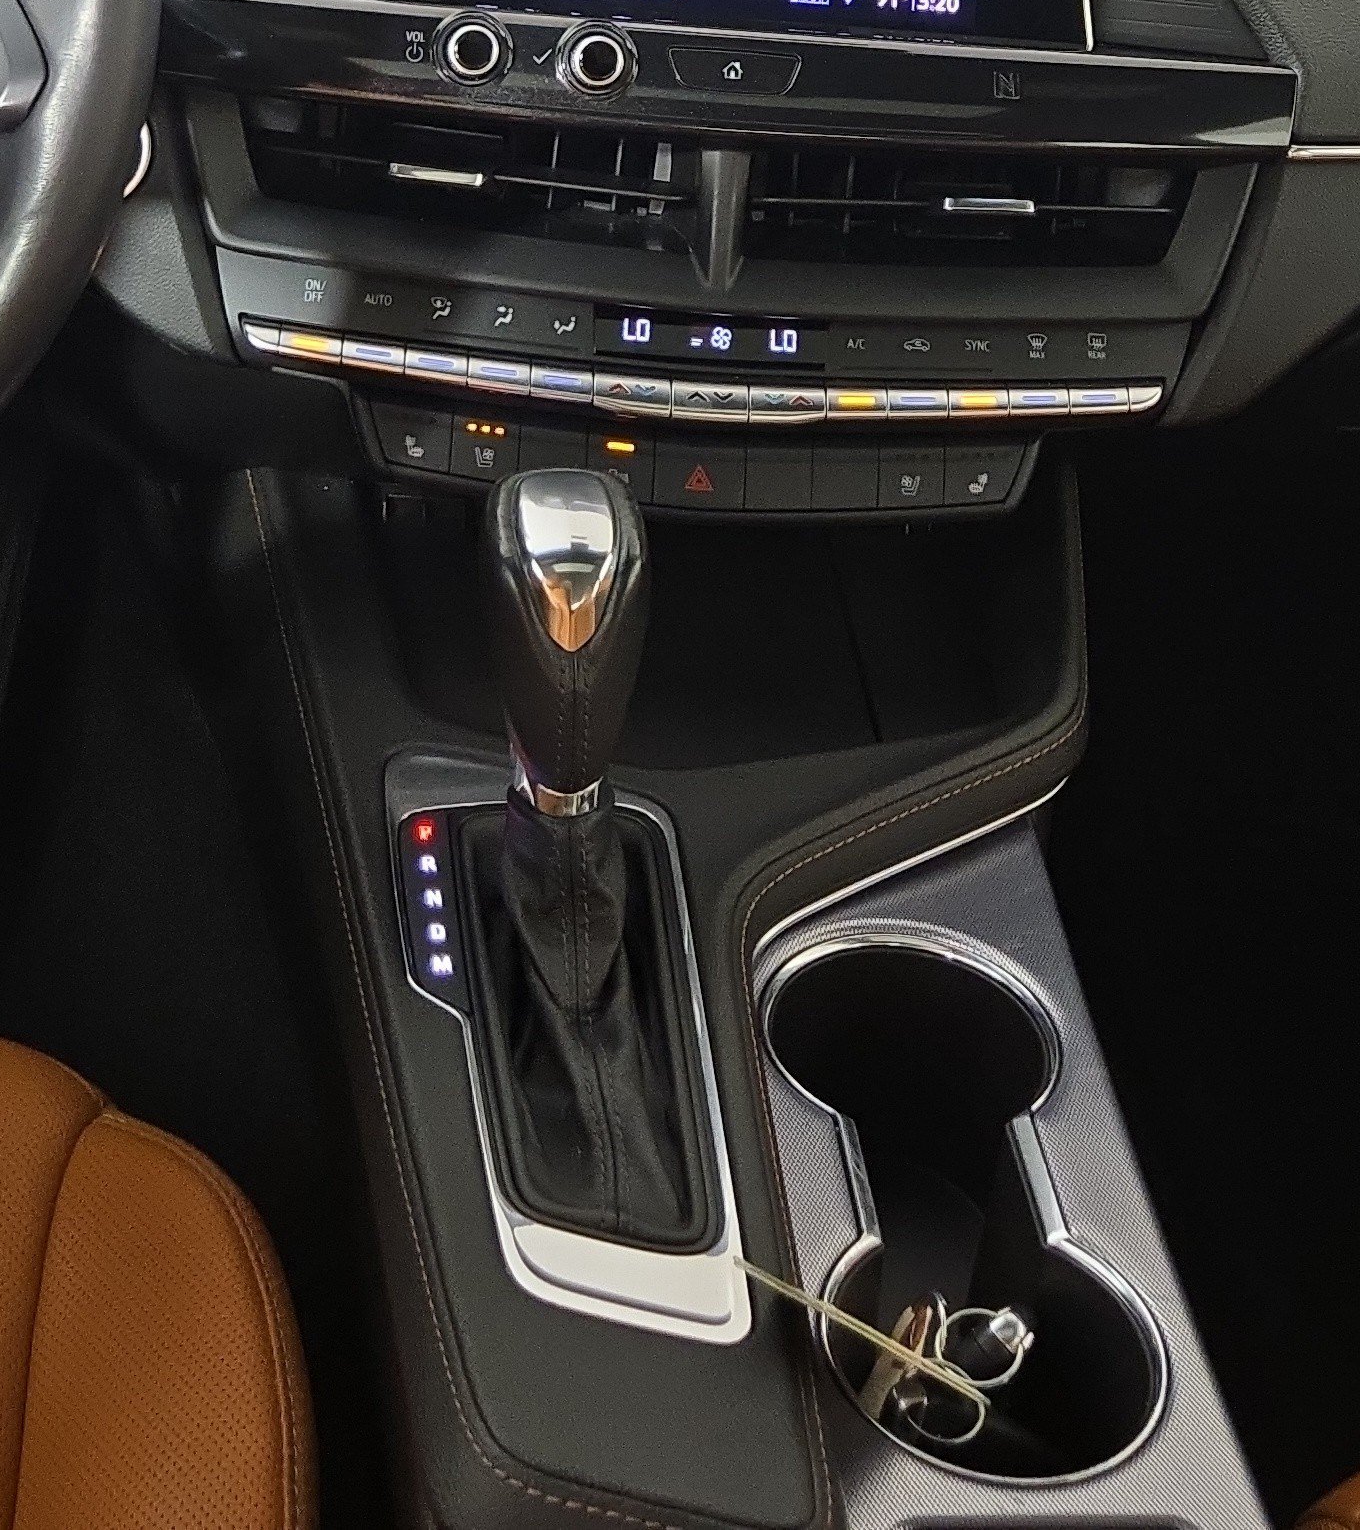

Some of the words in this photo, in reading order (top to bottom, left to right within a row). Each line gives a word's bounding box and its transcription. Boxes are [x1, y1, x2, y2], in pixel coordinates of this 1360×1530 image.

[405, 30, 425, 42] VOL
[305, 279, 327, 291] ON/
[304, 290, 325, 303] OFF
[364, 293, 393, 307] AUTO
[847, 338, 866, 350] A/C
[964, 338, 991, 353] SYNC
[419, 855, 438, 873] R
[424, 889, 443, 907] N
[428, 923, 446, 942] D
[431, 955, 454, 974] M
